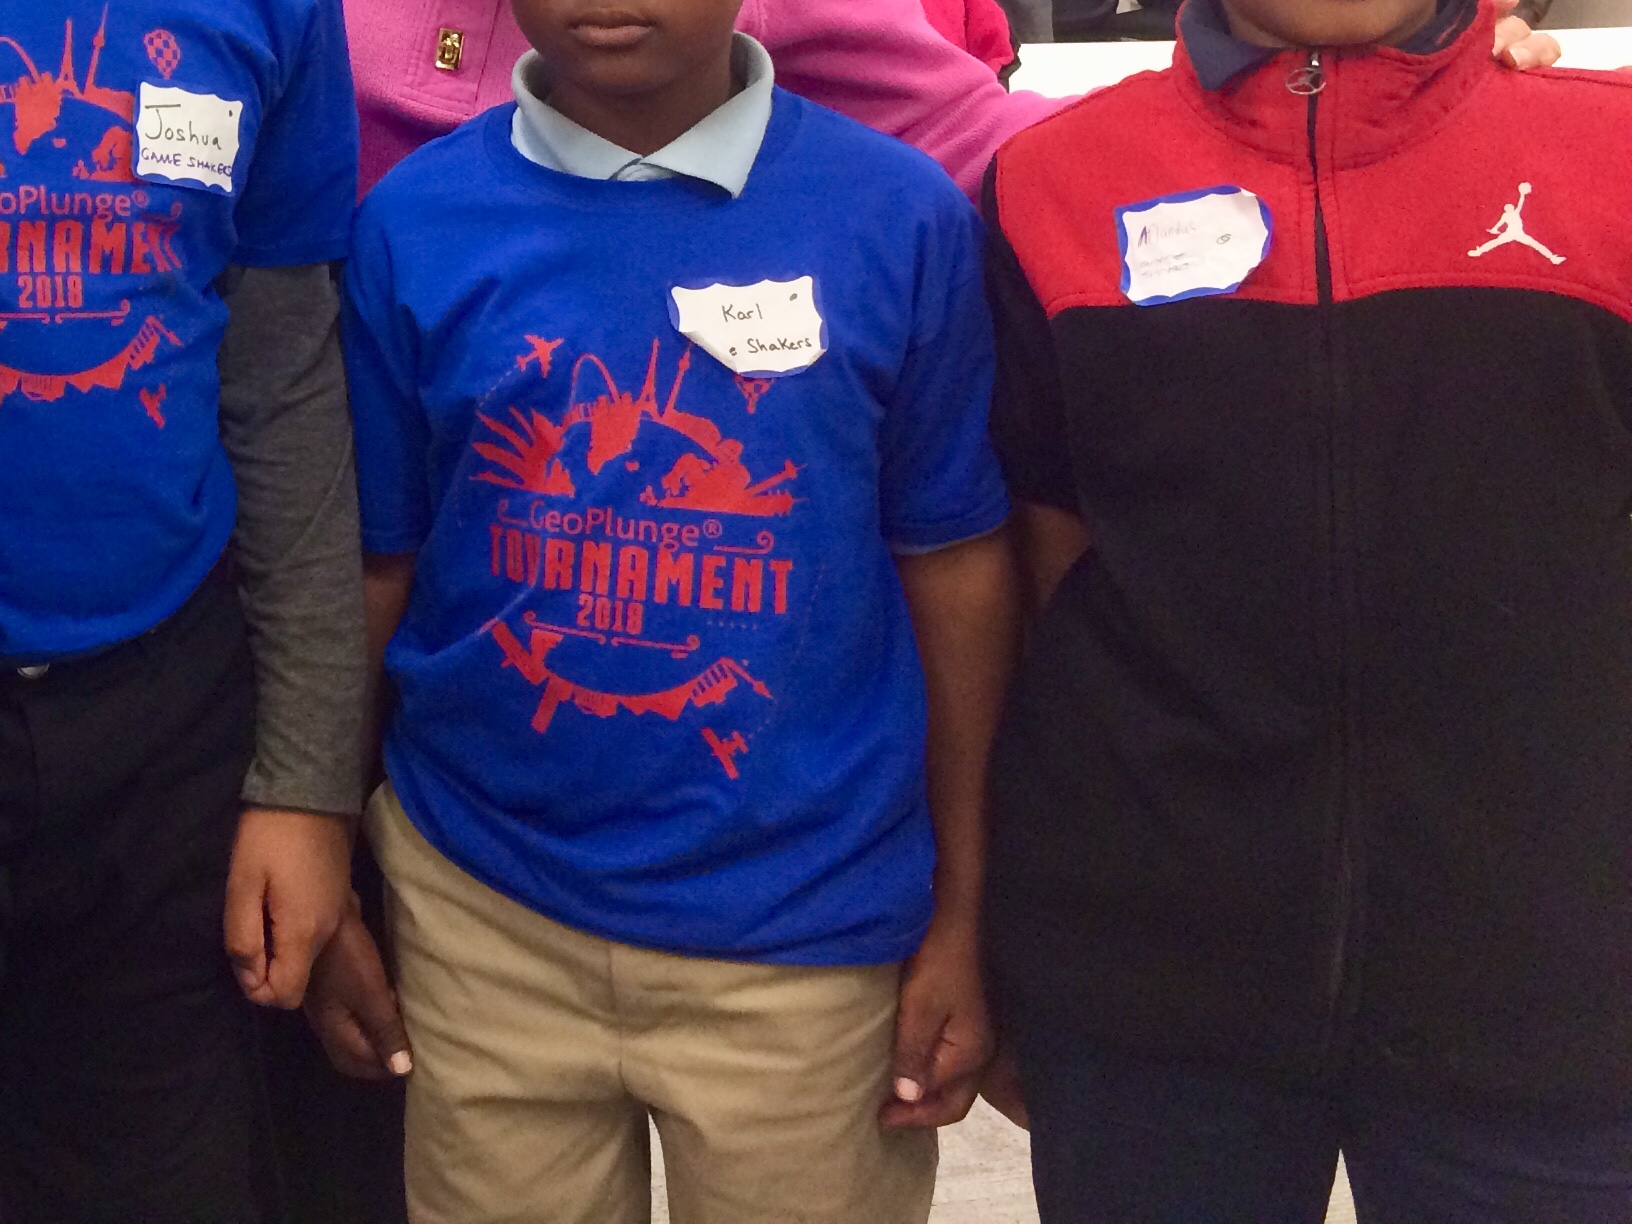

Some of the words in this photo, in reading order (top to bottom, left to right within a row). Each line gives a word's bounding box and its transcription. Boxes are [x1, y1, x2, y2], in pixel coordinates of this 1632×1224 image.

[145, 103, 222, 150] Joshua
[141, 147, 181, 167] GAME
[18, 275, 83, 308] 2018
[721, 303, 763, 322] Karl
[577, 593, 643, 635] 2018
